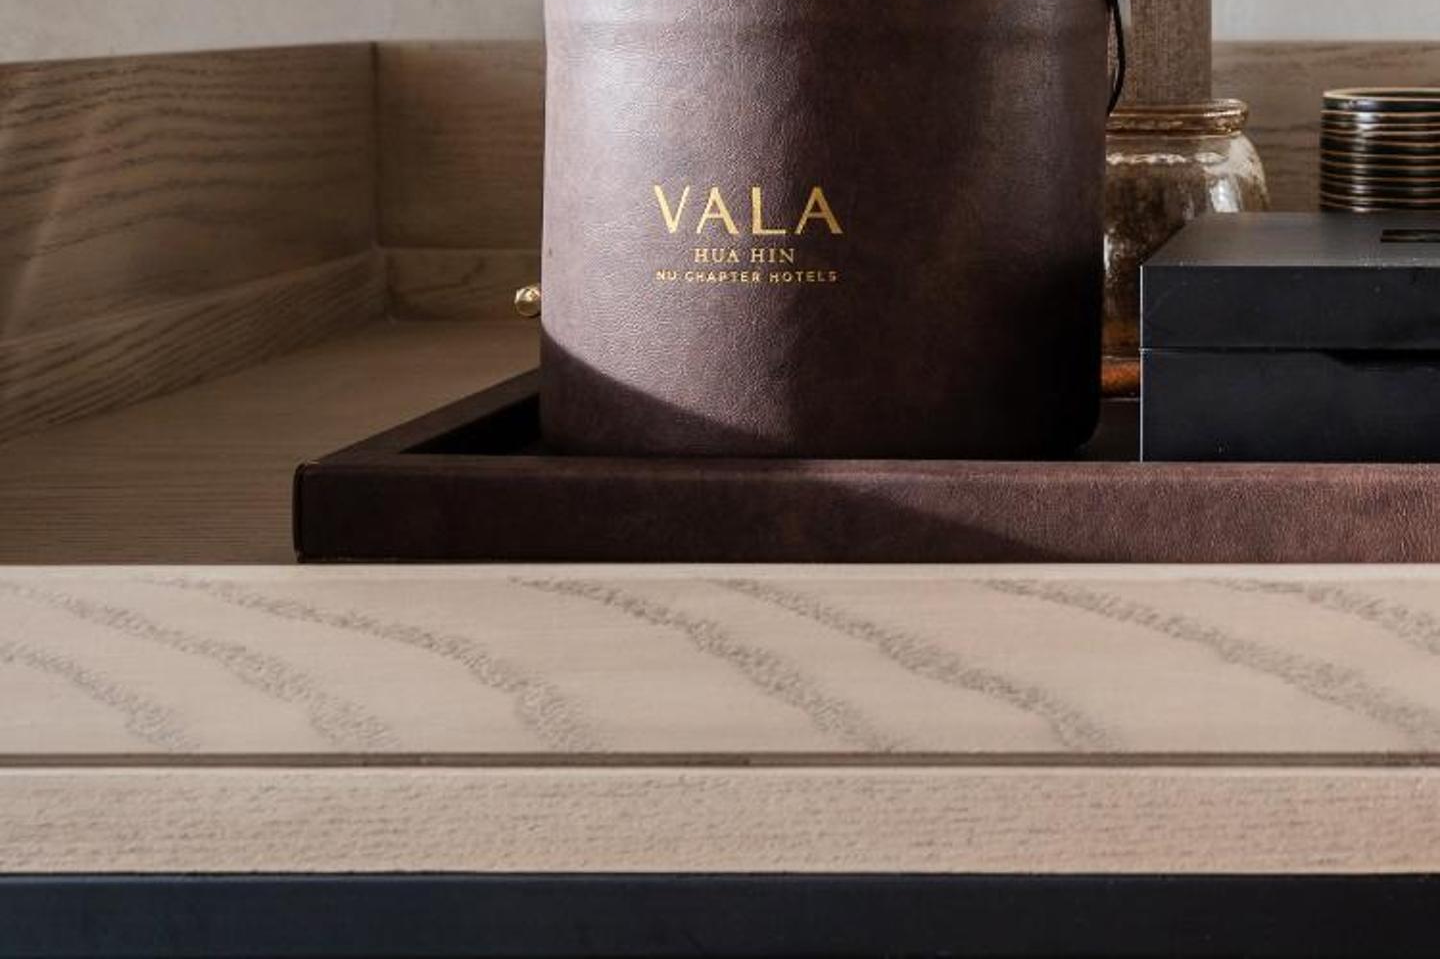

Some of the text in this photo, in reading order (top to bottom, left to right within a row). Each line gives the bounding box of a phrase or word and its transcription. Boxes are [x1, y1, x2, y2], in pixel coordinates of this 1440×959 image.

[654, 185, 843, 234] VALA
[694, 248, 795, 263] HUA HIN
[655, 271, 837, 282] NU CHAPTER HOTELS
